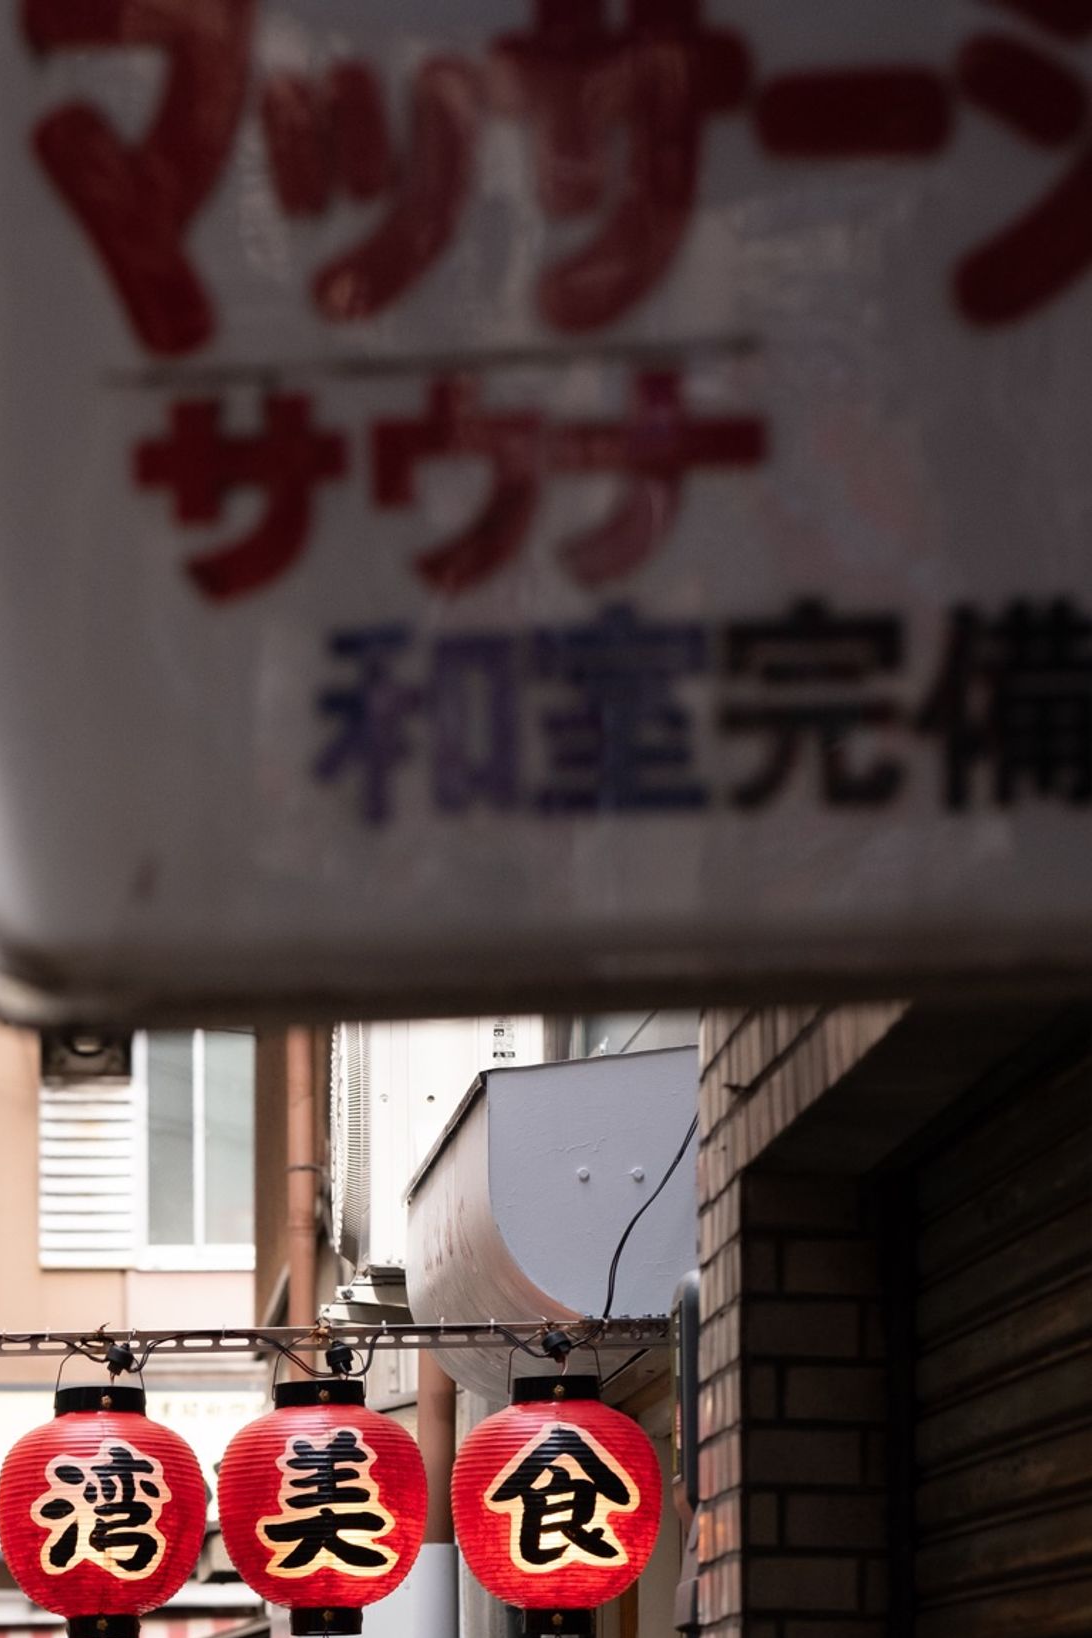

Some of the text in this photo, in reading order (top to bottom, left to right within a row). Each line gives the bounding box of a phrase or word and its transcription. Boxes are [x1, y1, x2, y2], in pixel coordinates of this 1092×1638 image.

[131, 370, 772, 607] サウナ
[36, 1441, 168, 1577] 湾
[259, 1427, 394, 1573] 美
[486, 1423, 636, 1570] 食
